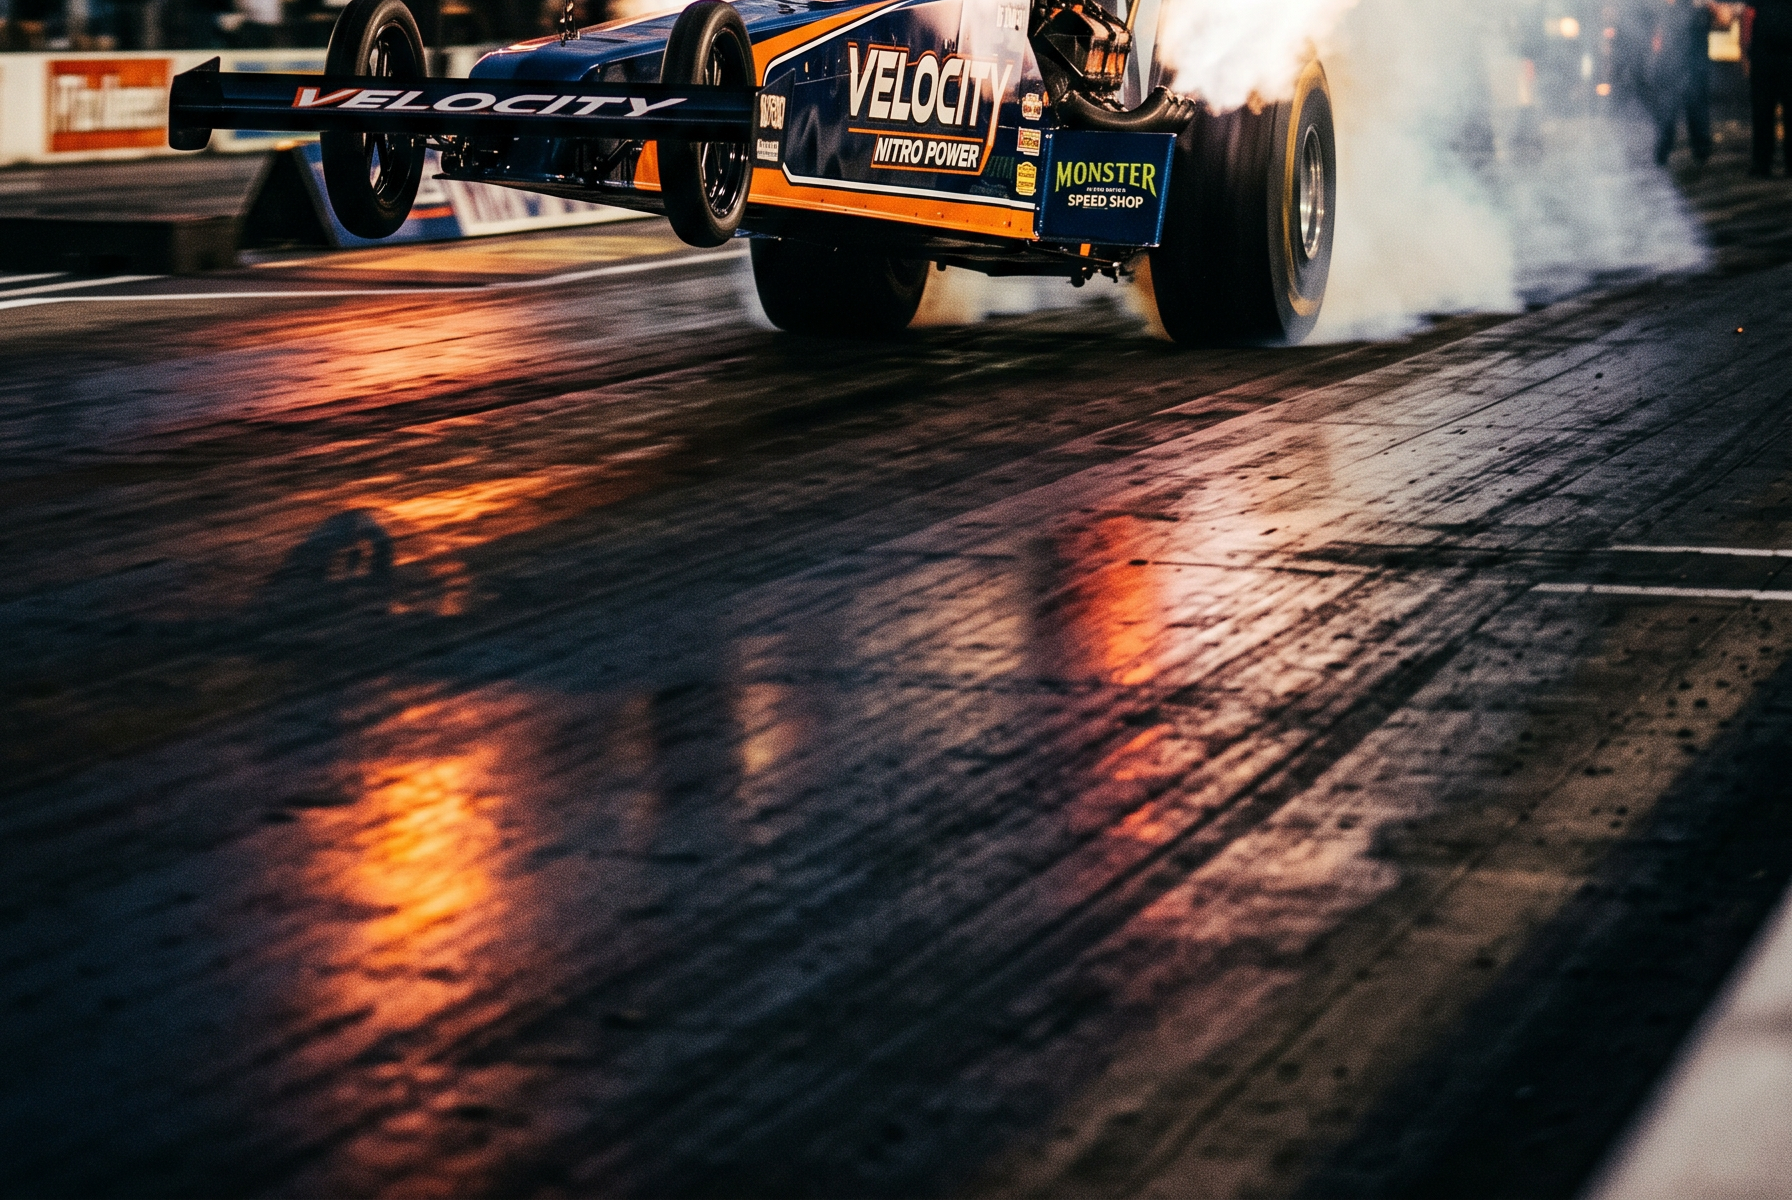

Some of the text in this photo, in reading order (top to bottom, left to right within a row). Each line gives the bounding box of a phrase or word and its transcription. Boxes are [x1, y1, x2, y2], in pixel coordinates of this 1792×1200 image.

[291, 87, 688, 117] VELOCITY
[848, 44, 1014, 146] VELOCITY
[873, 137, 980, 169] NITRO POWER
[1055, 161, 1157, 198] MONSTER
[1067, 194, 1144, 209] SPEED SHOP
